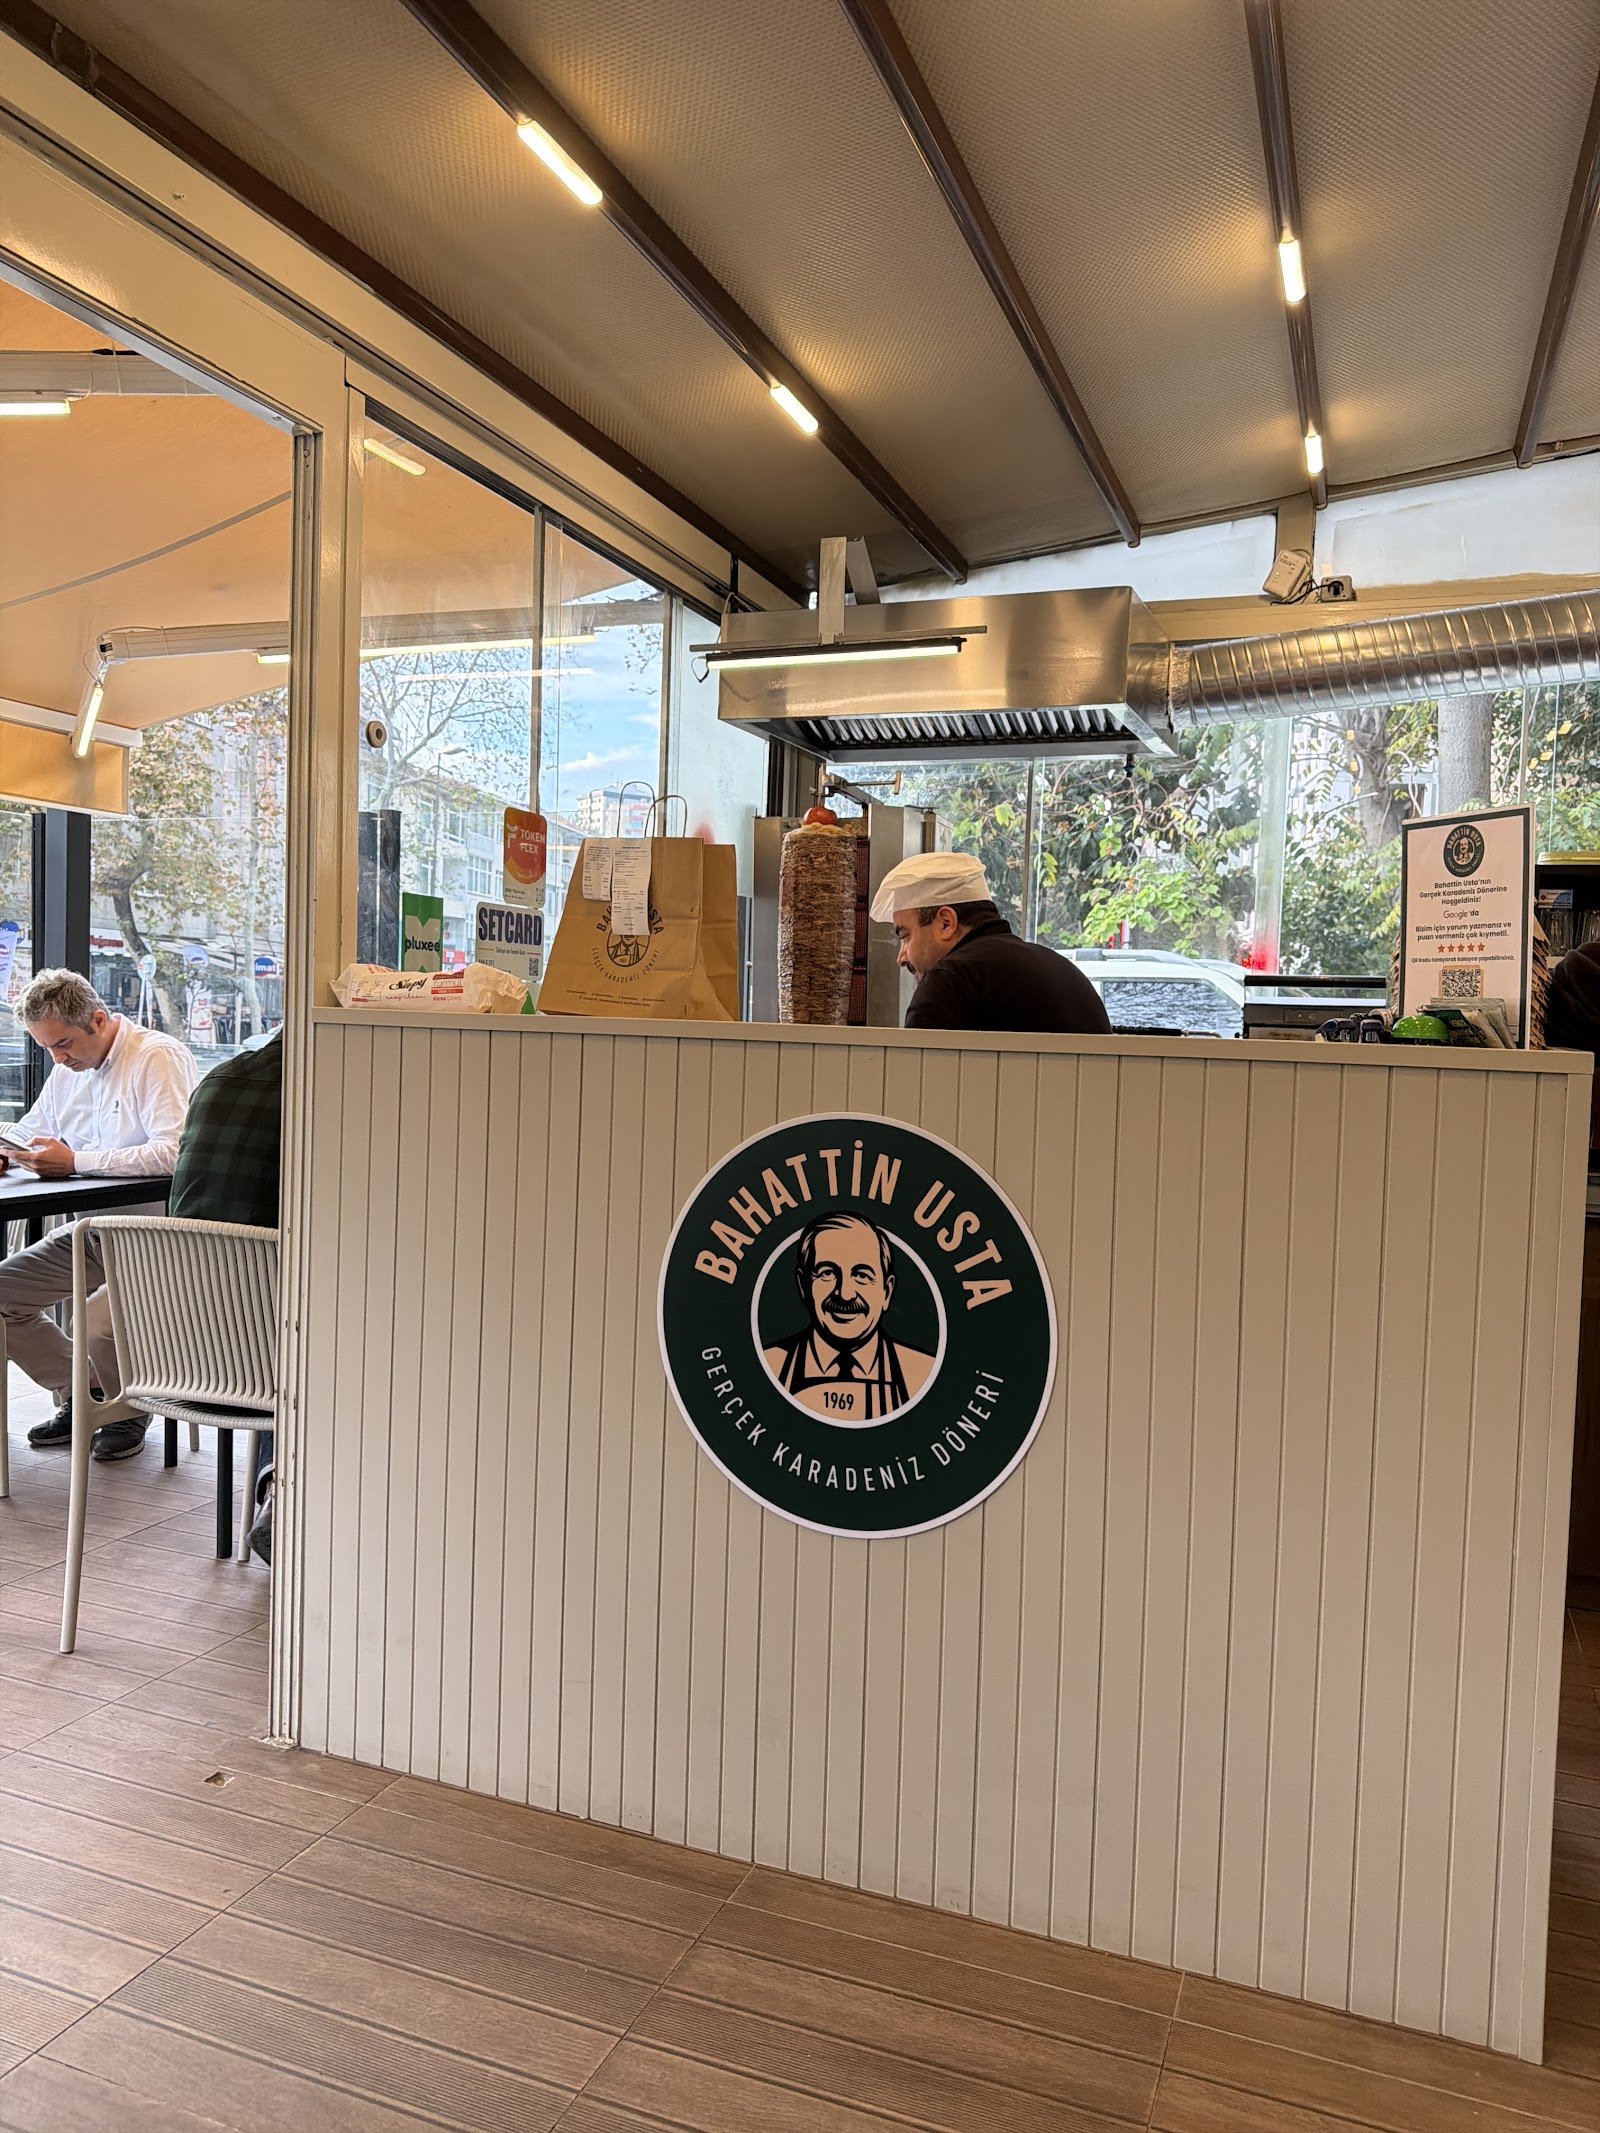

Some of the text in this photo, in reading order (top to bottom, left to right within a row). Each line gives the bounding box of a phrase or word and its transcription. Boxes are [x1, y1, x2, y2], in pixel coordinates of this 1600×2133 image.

[520, 828, 545, 844] TOKEN
[520, 843, 539, 855] FLEX
[1434, 879, 1491, 889] Bahattin Usta'nın
[1419, 885, 1508, 900] Gerçek Karadeniz Dönerine
[1441, 896, 1481, 906] Hoşgeldiniz!
[478, 906, 542, 946] SETCARD
[1433, 924, 1446, 933] için
[1446, 924, 1468, 933] yorum
[1469, 922, 1502, 931] yazmanız
[405, 936, 440, 952] pluxee
[1417, 933, 1434, 942] puan
[1434, 931, 1465, 939] vermeniz
[1465, 931, 1478, 940] çok
[694, 1140, 1014, 1311] BAHATTİN USTA
[823, 1391, 854, 1411] 1969
[701, 1346, 1004, 1492] GERÇEK KARADENİZ DÖNERİ
